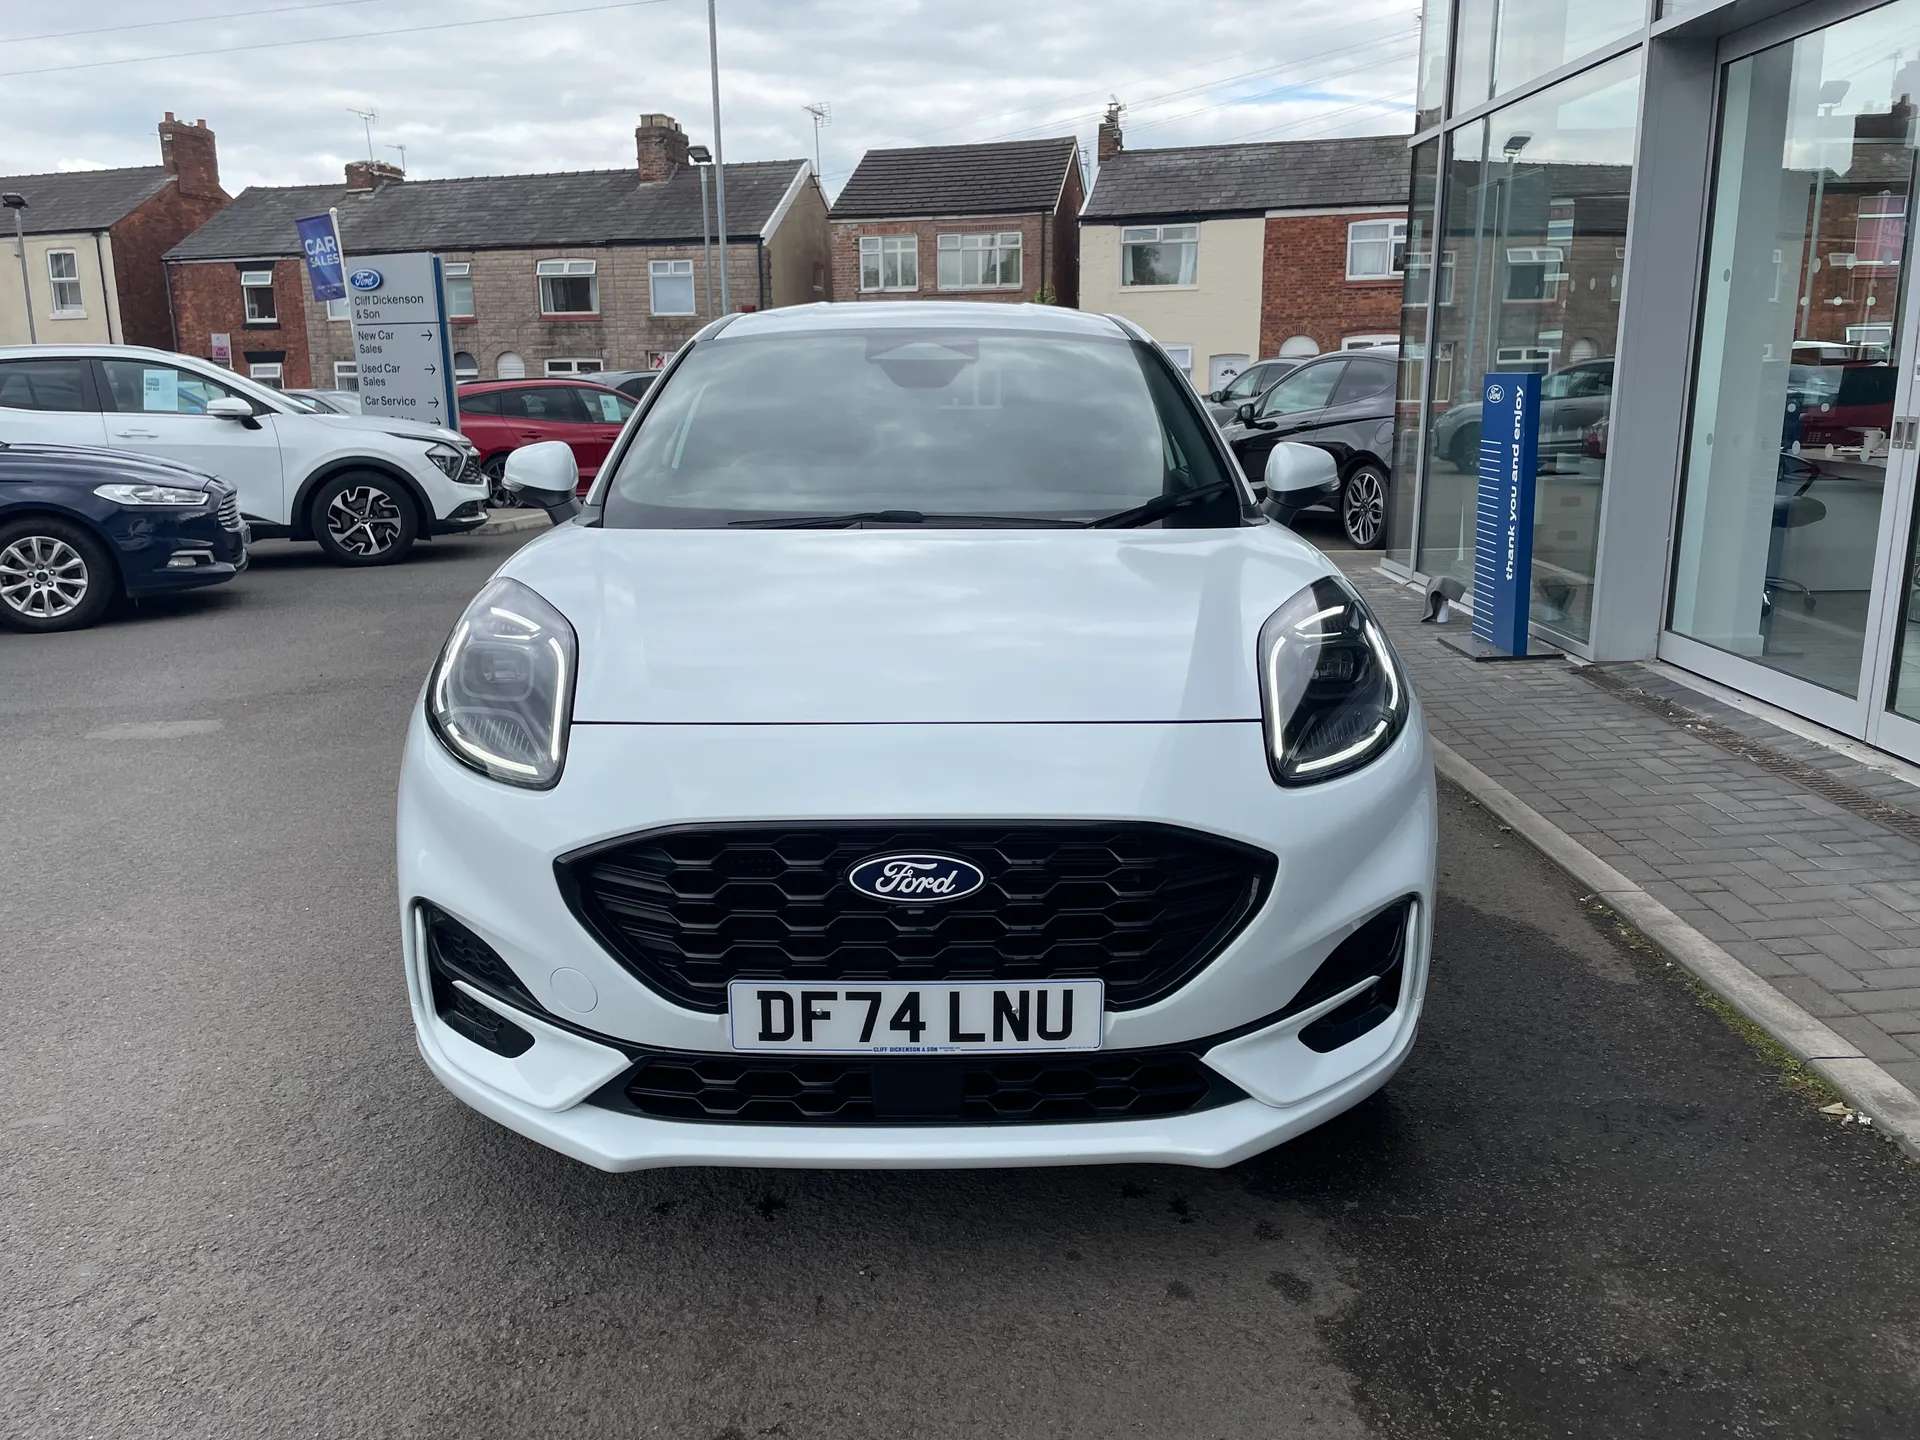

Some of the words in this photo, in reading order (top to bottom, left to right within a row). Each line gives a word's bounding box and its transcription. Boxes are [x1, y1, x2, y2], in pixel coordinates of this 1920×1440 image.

[304, 235, 337, 256] CAR
[310, 253, 340, 268] SALES
[355, 272, 374, 287] Ford
[354, 295, 371, 306] Cliff
[372, 295, 424, 305] Dickenson
[356, 309, 362, 319] &
[363, 309, 380, 319] Son
[358, 331, 376, 341] New
[378, 330, 394, 340] Car
[360, 344, 383, 354] Sales
[361, 363, 383, 373] Used
[384, 363, 400, 373] Car
[363, 377, 386, 387] Sales
[365, 396, 379, 406] Car
[380, 395, 417, 406] Service
[1513, 384, 1524, 440] enjoy
[1511, 443, 1520, 483] and
[1510, 485, 1518, 521] you
[1505, 525, 1515, 580] thank
[875, 861, 959, 894] Ford
[756, 990, 926, 1043] DF74
[949, 989, 1074, 1043] LNU
